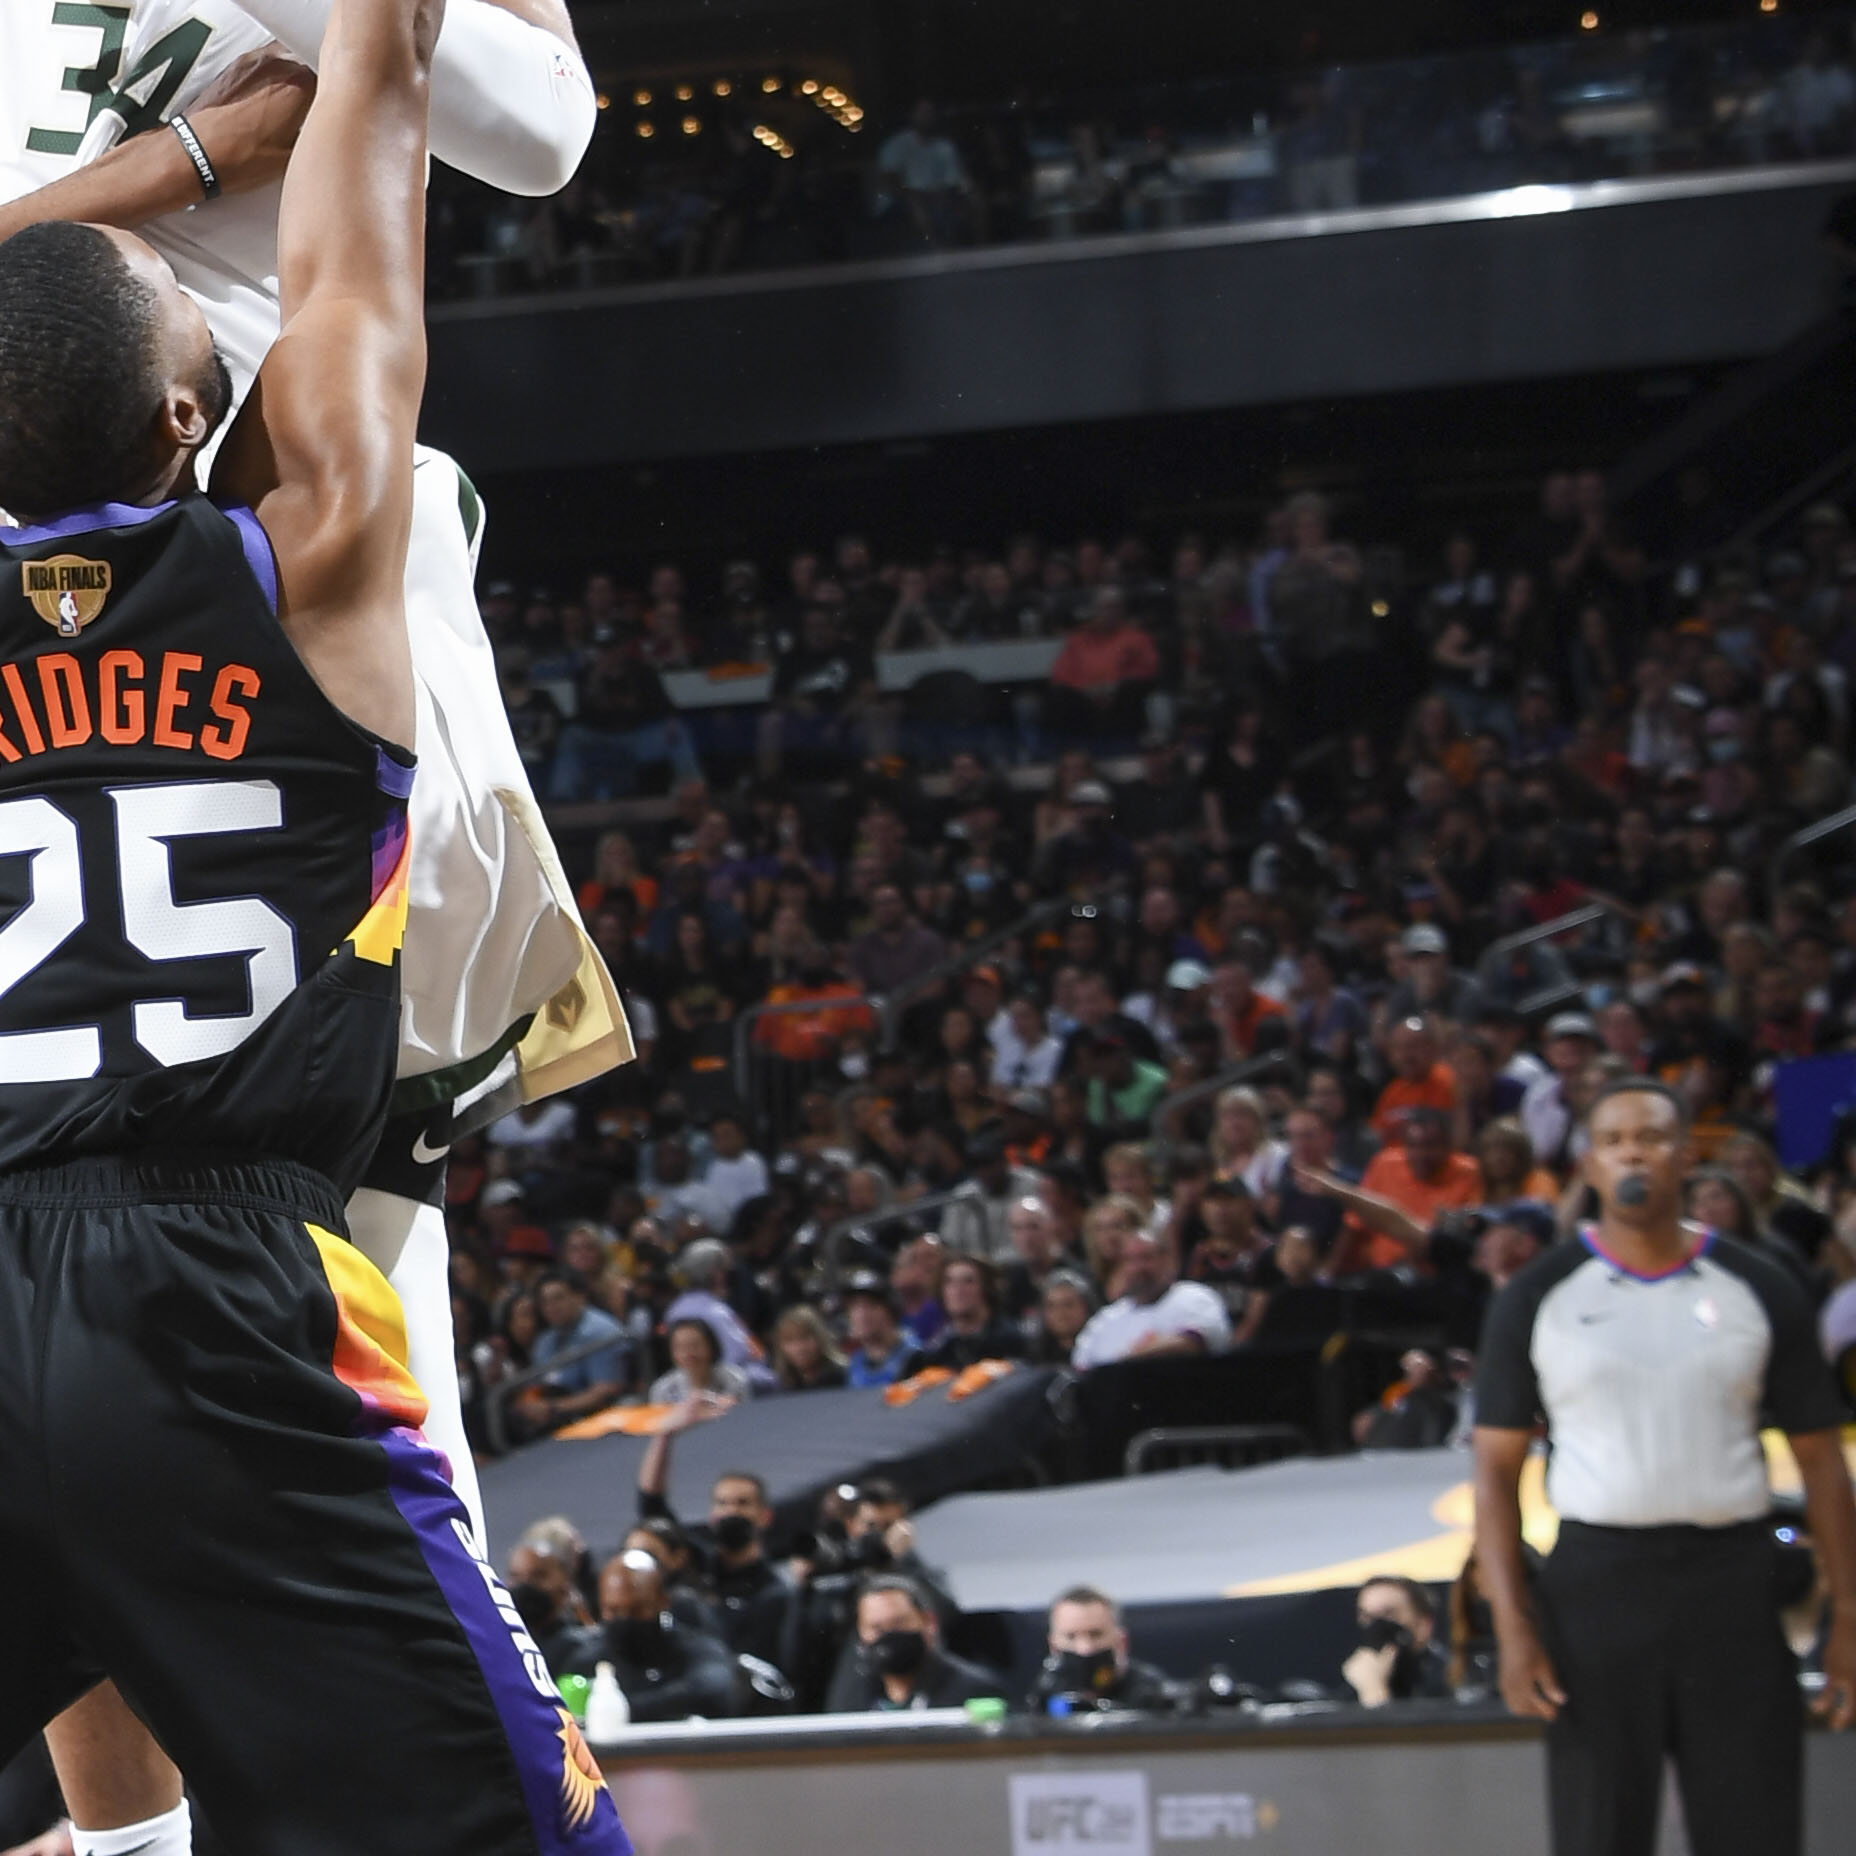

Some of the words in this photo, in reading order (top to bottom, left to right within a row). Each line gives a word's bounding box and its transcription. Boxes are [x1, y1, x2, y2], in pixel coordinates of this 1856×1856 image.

[25, 0, 218, 156] 34
[29, 566, 57, 591] NBA
[59, 565, 107, 591] FINALS
